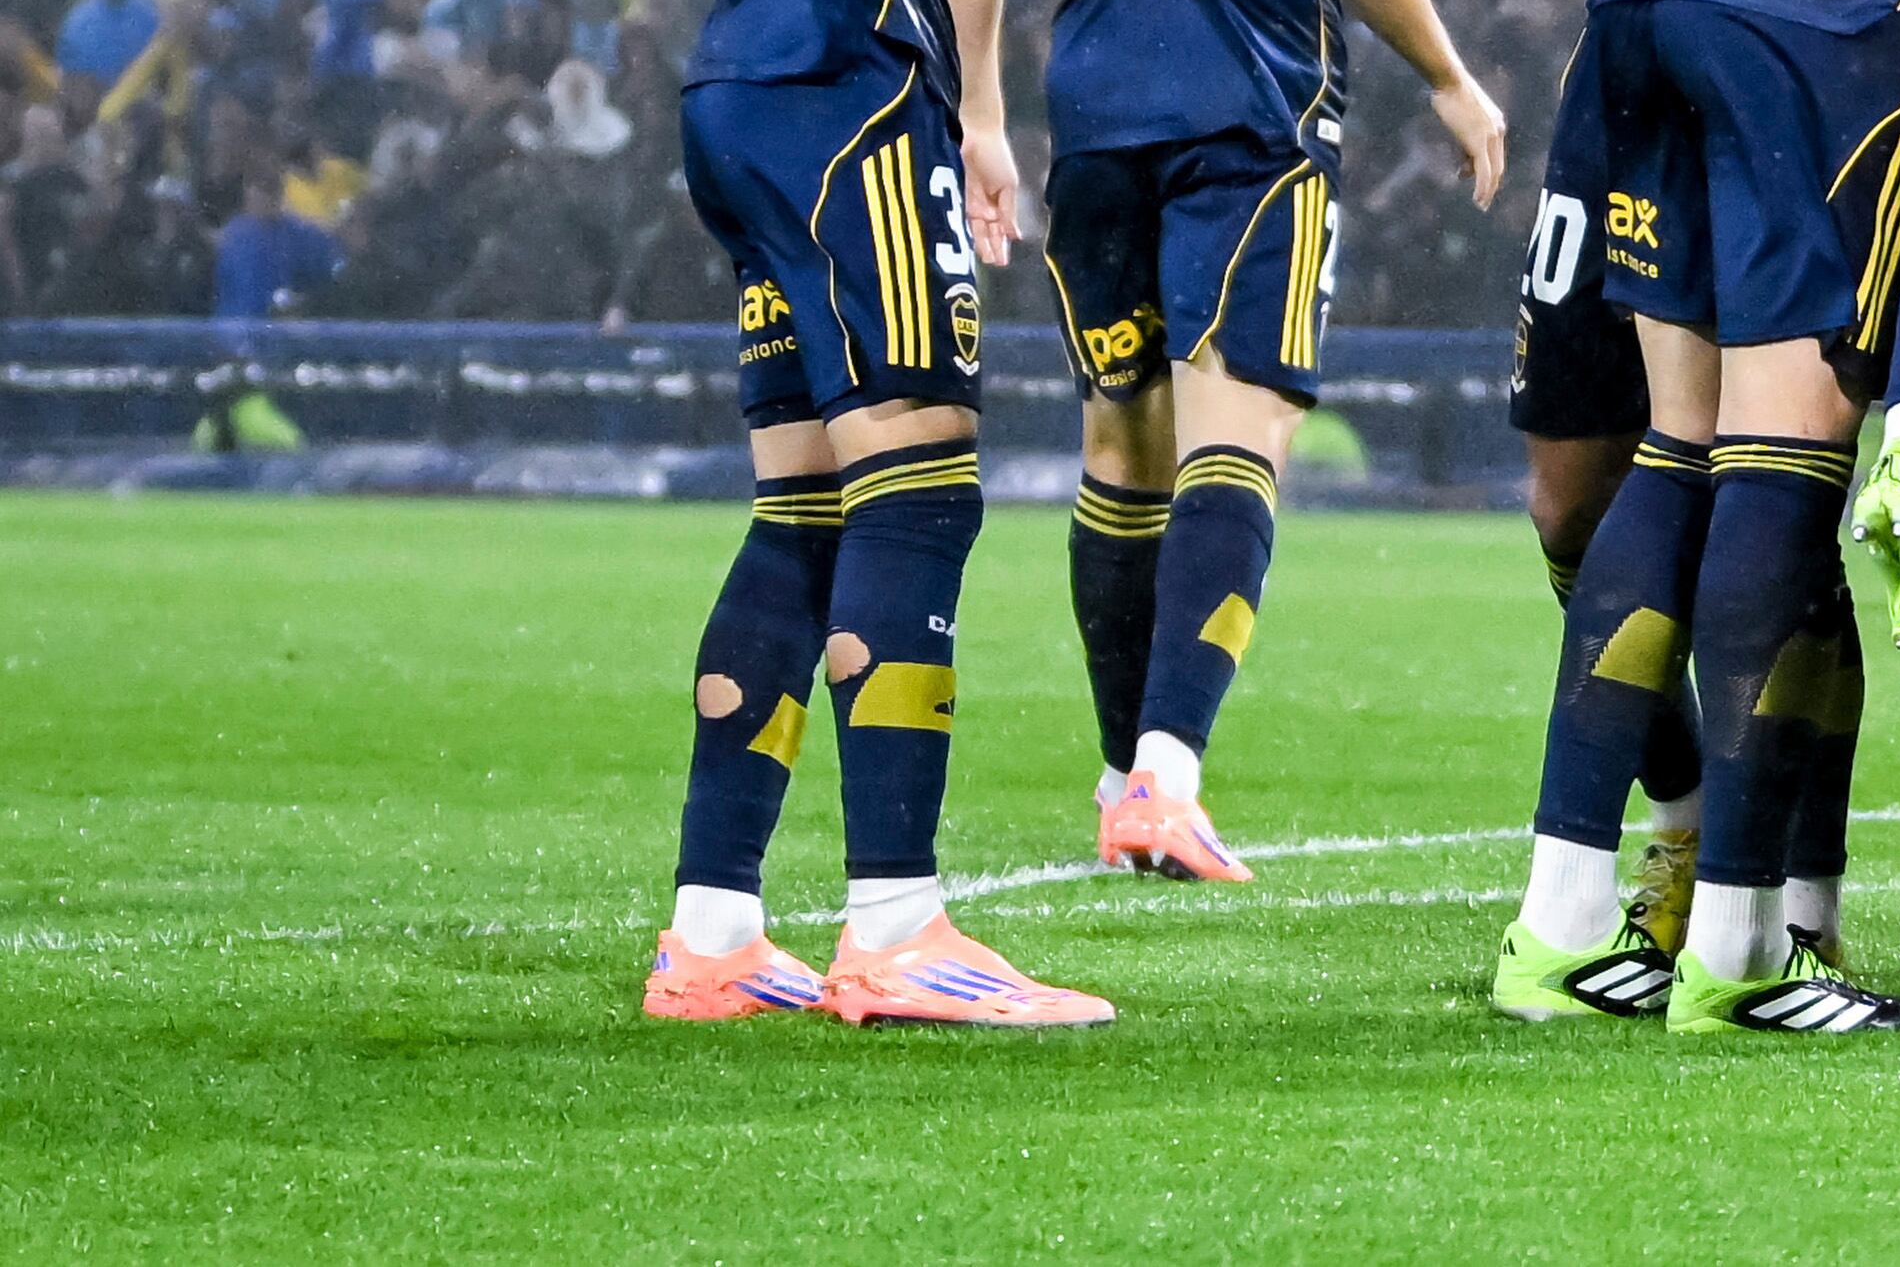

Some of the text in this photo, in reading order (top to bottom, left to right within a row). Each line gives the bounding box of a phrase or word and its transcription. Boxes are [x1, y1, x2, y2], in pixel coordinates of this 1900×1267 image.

[928, 165, 976, 276] 3
[1521, 187, 1588, 305] 0
[1604, 191, 1659, 249] ax
[738, 279, 791, 335] ax
